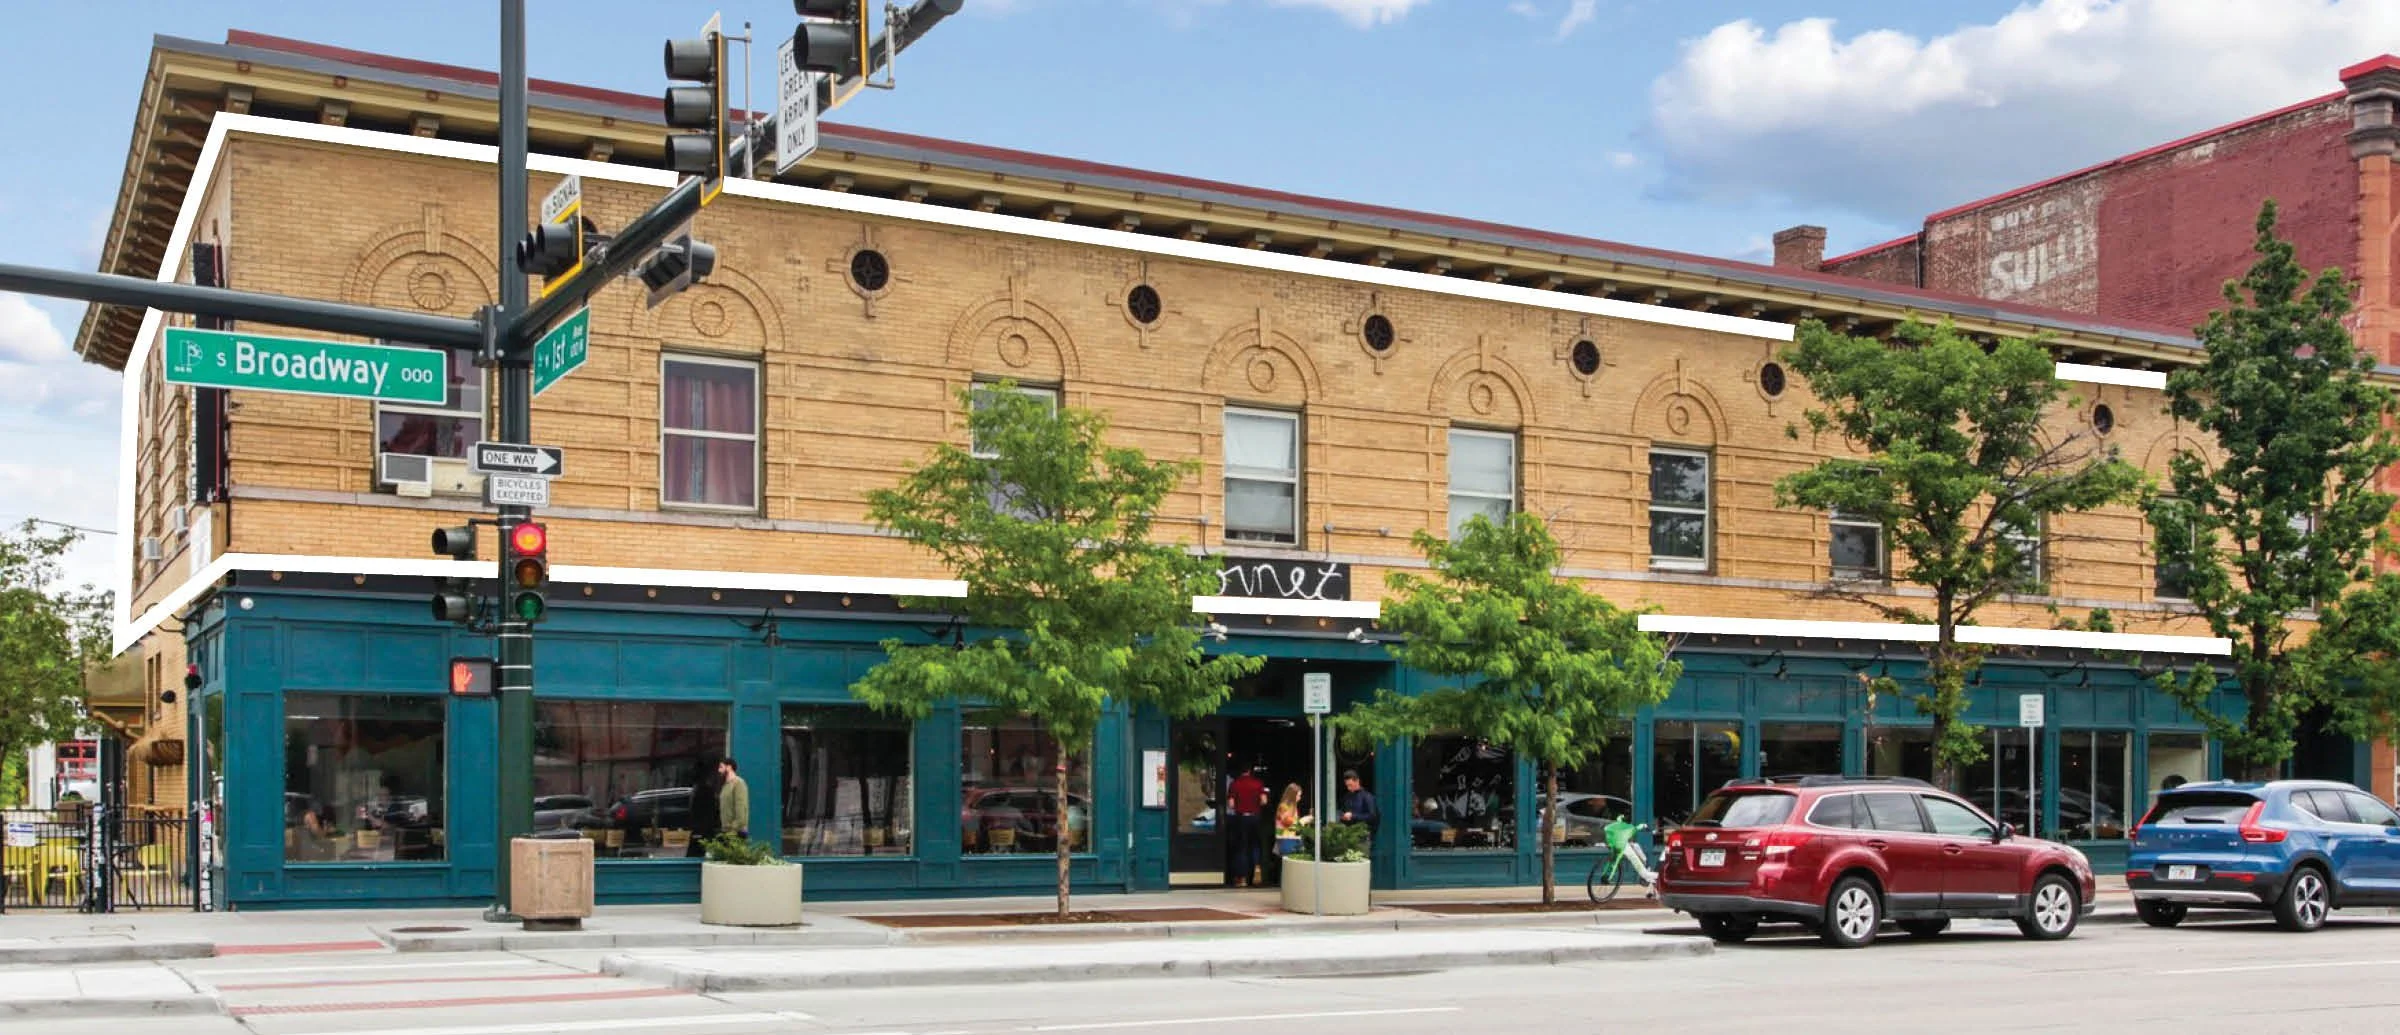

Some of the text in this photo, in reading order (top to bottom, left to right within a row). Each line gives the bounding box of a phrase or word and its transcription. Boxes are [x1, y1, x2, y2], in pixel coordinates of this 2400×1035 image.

[784, 69, 809, 101] GREEN
[784, 92, 810, 129] ARROW
[787, 123, 805, 154] ONLY
[552, 176, 578, 215] SIGNAL
[216, 352, 227, 367] S
[236, 341, 389, 395] Broadway
[485, 451, 536, 465] ONE WAY
[496, 490, 543, 501] EXCEPTED
[497, 478, 541, 490] BICYCLES
[1215, 562, 1344, 601] ornet
